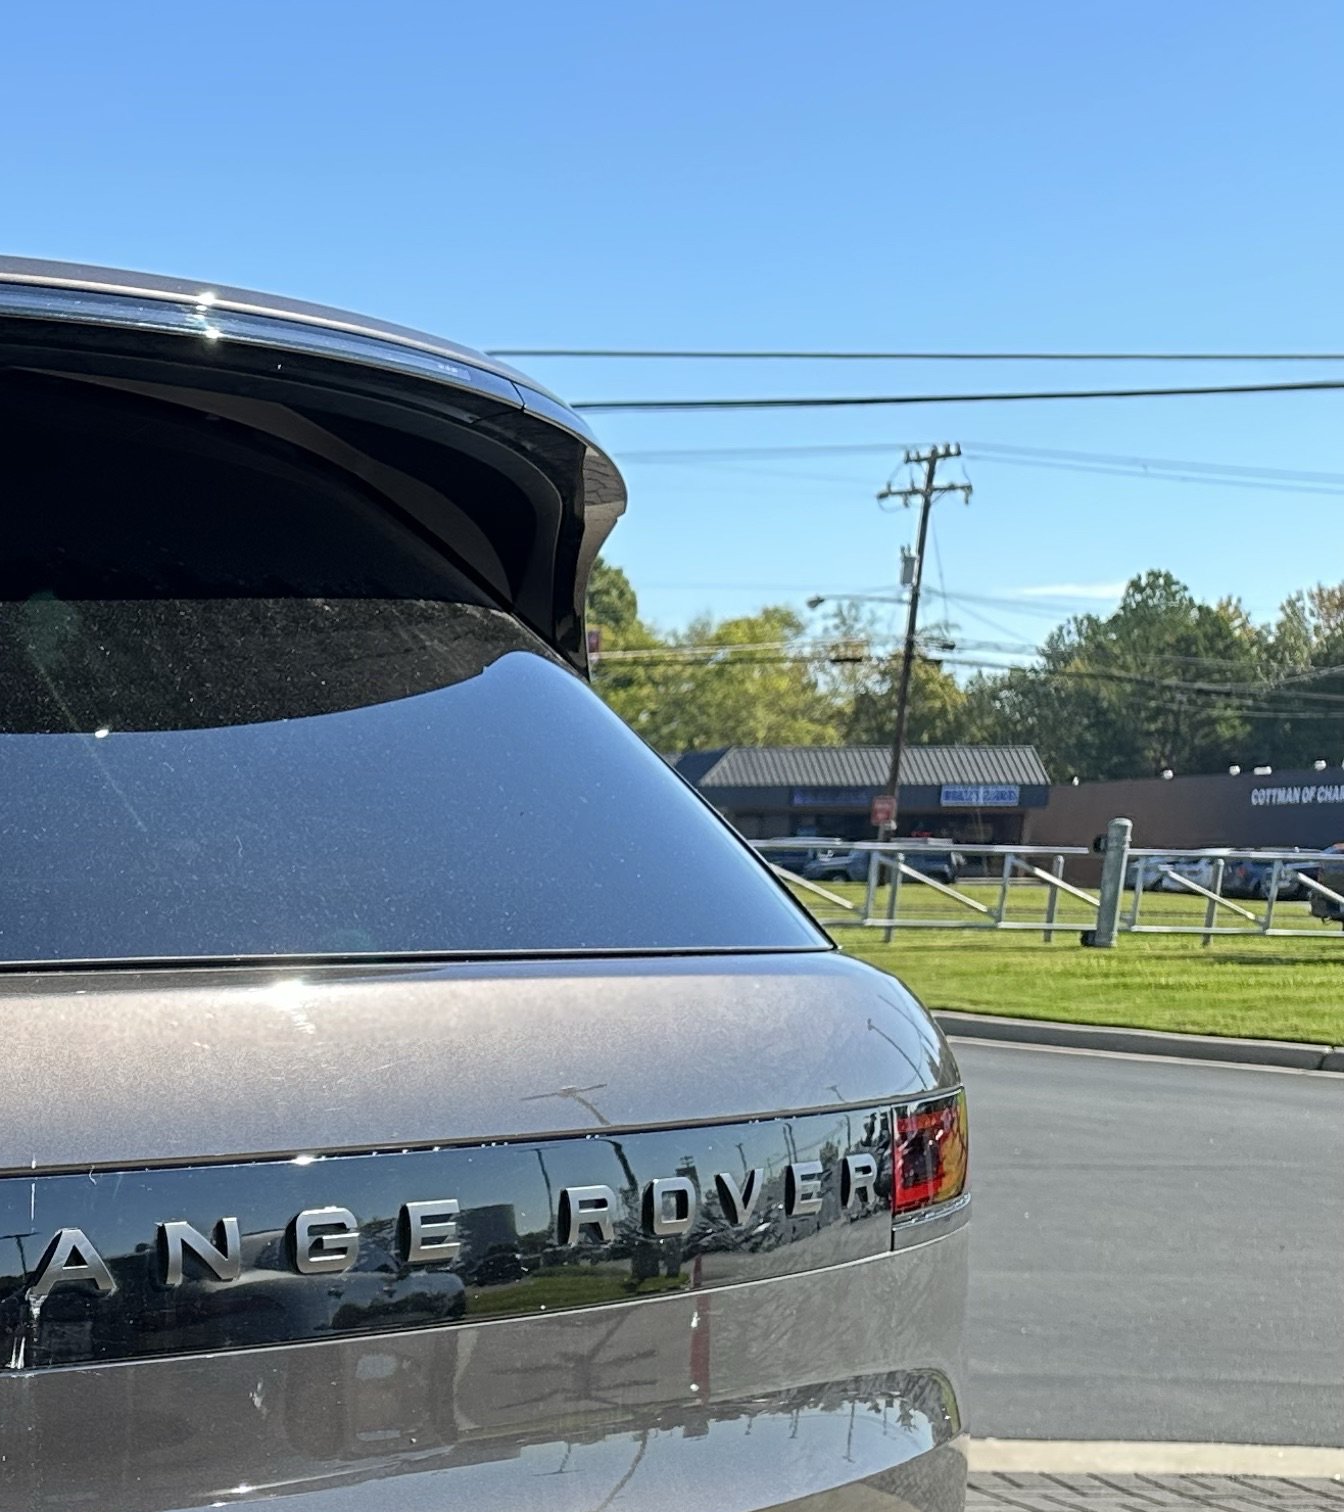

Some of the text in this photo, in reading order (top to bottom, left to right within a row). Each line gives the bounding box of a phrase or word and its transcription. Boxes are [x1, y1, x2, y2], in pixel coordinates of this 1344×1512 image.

[1252, 788, 1300, 805] COTTMAN
[1302, 786, 1316, 803] OF
[557, 1152, 878, 1247] ROVER
